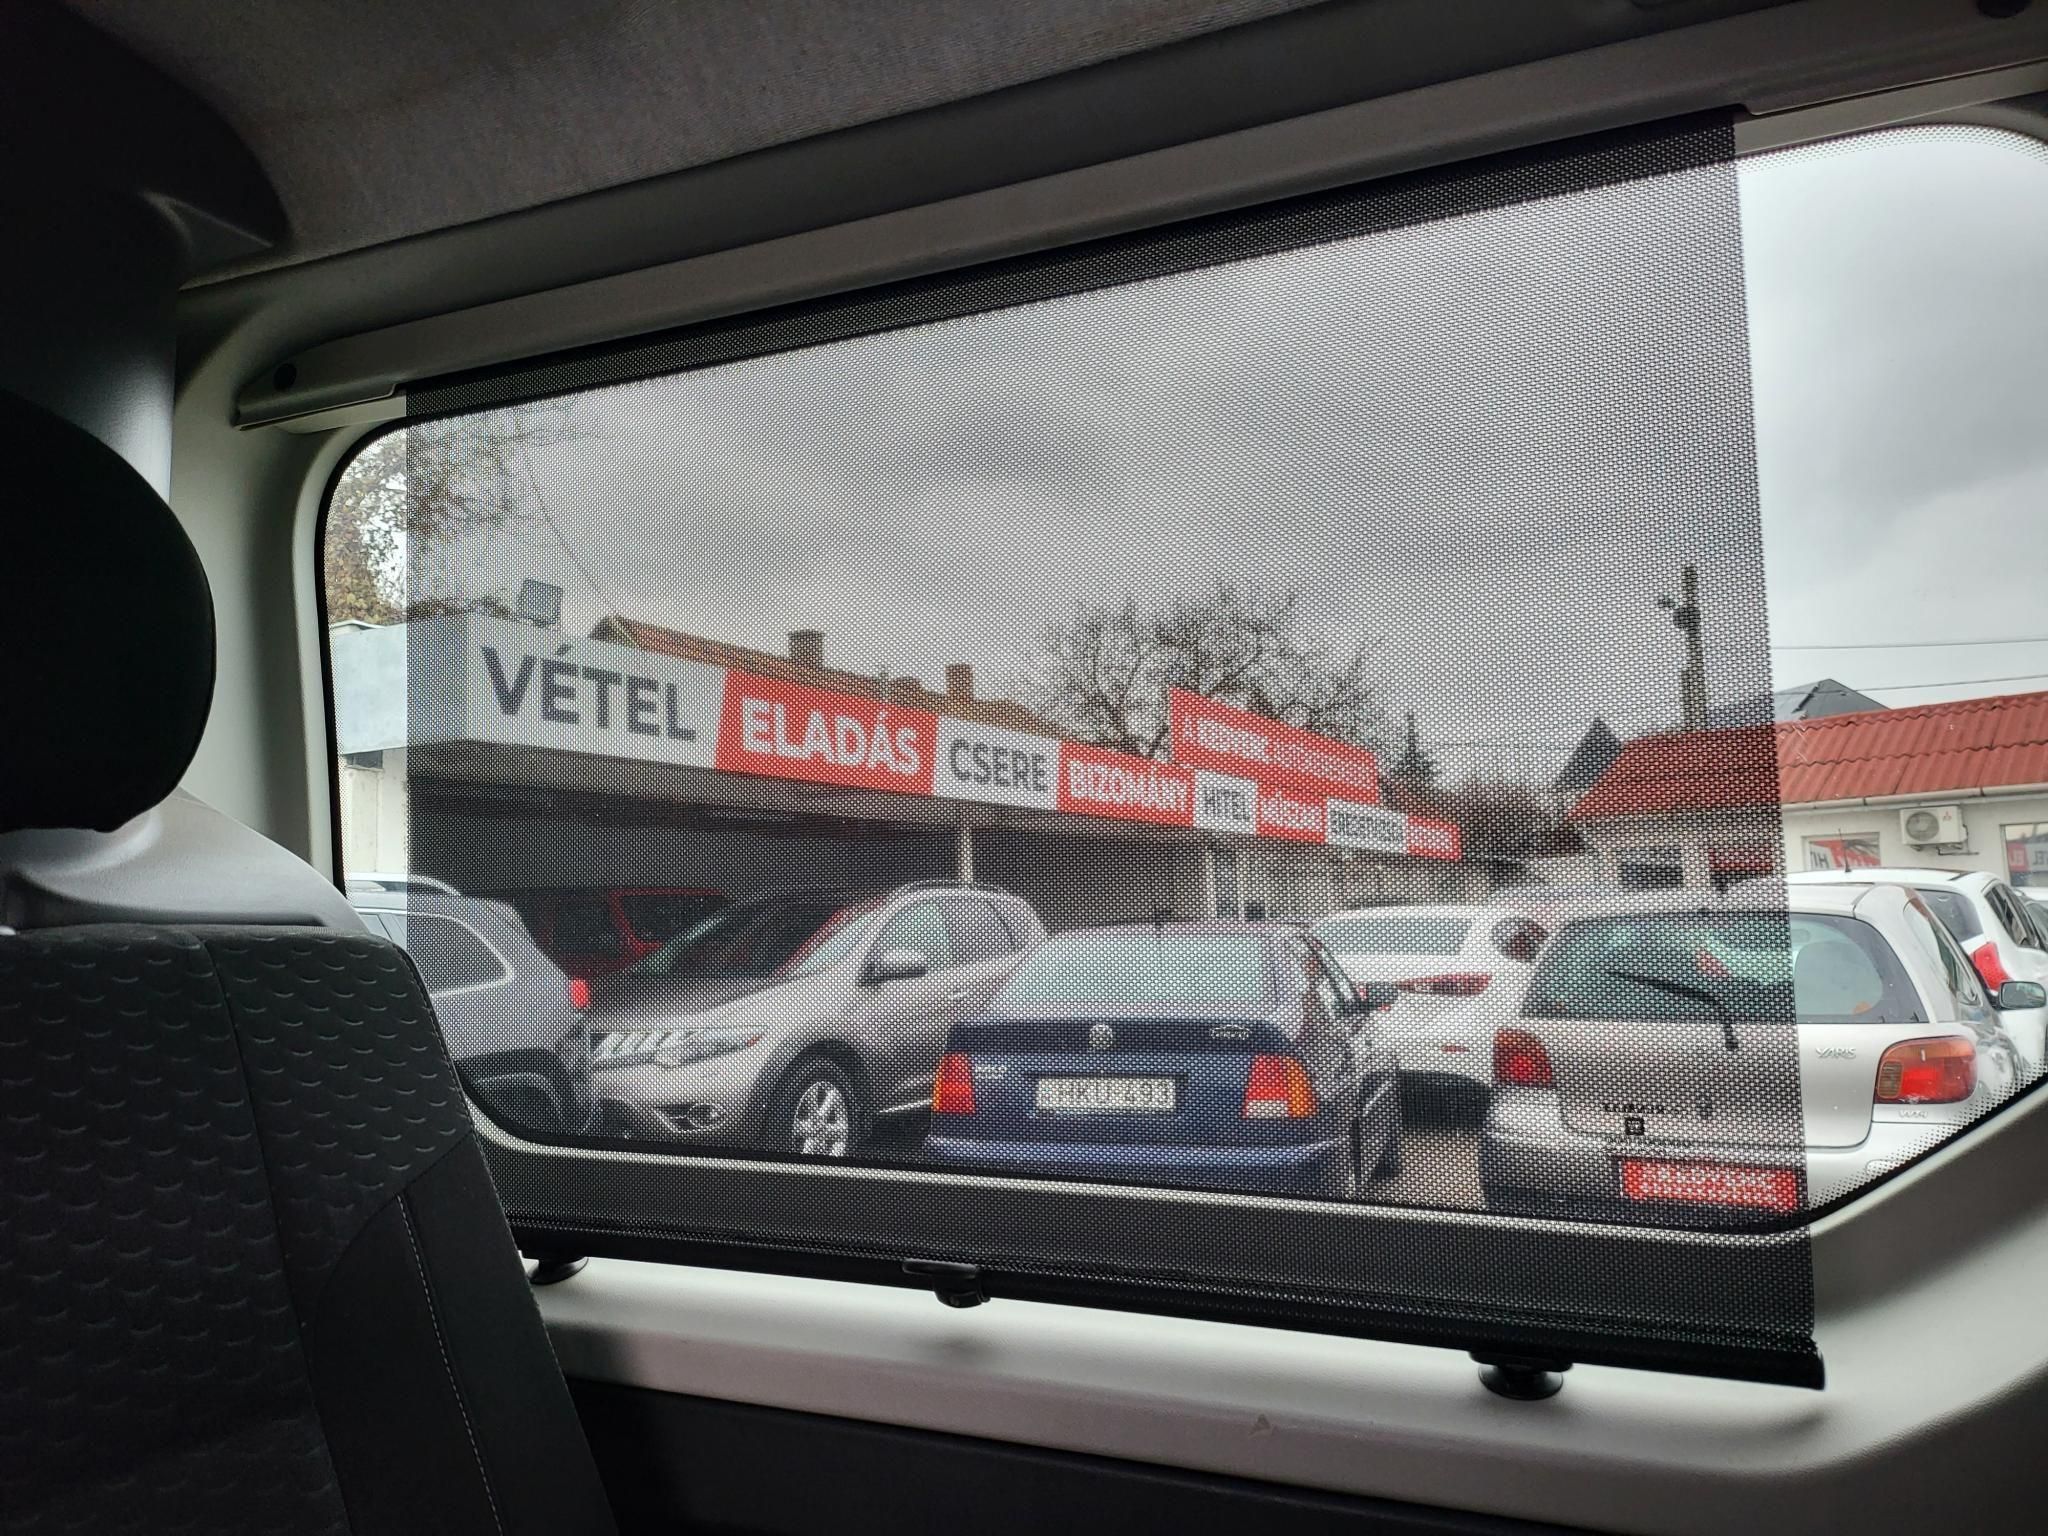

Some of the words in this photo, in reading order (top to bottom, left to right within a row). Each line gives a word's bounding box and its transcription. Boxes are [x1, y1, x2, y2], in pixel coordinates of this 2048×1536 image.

[481, 645, 697, 742] VÉTEL
[741, 697, 921, 776] ELADÁS
[949, 737, 1048, 793] CSERE
[1067, 759, 1188, 813] BIZOMÁNY
[1203, 785, 1250, 823] HITEL
[1815, 1046, 1856, 1060] YARIS
[1058, 1081, 1169, 1105] HKU-493
